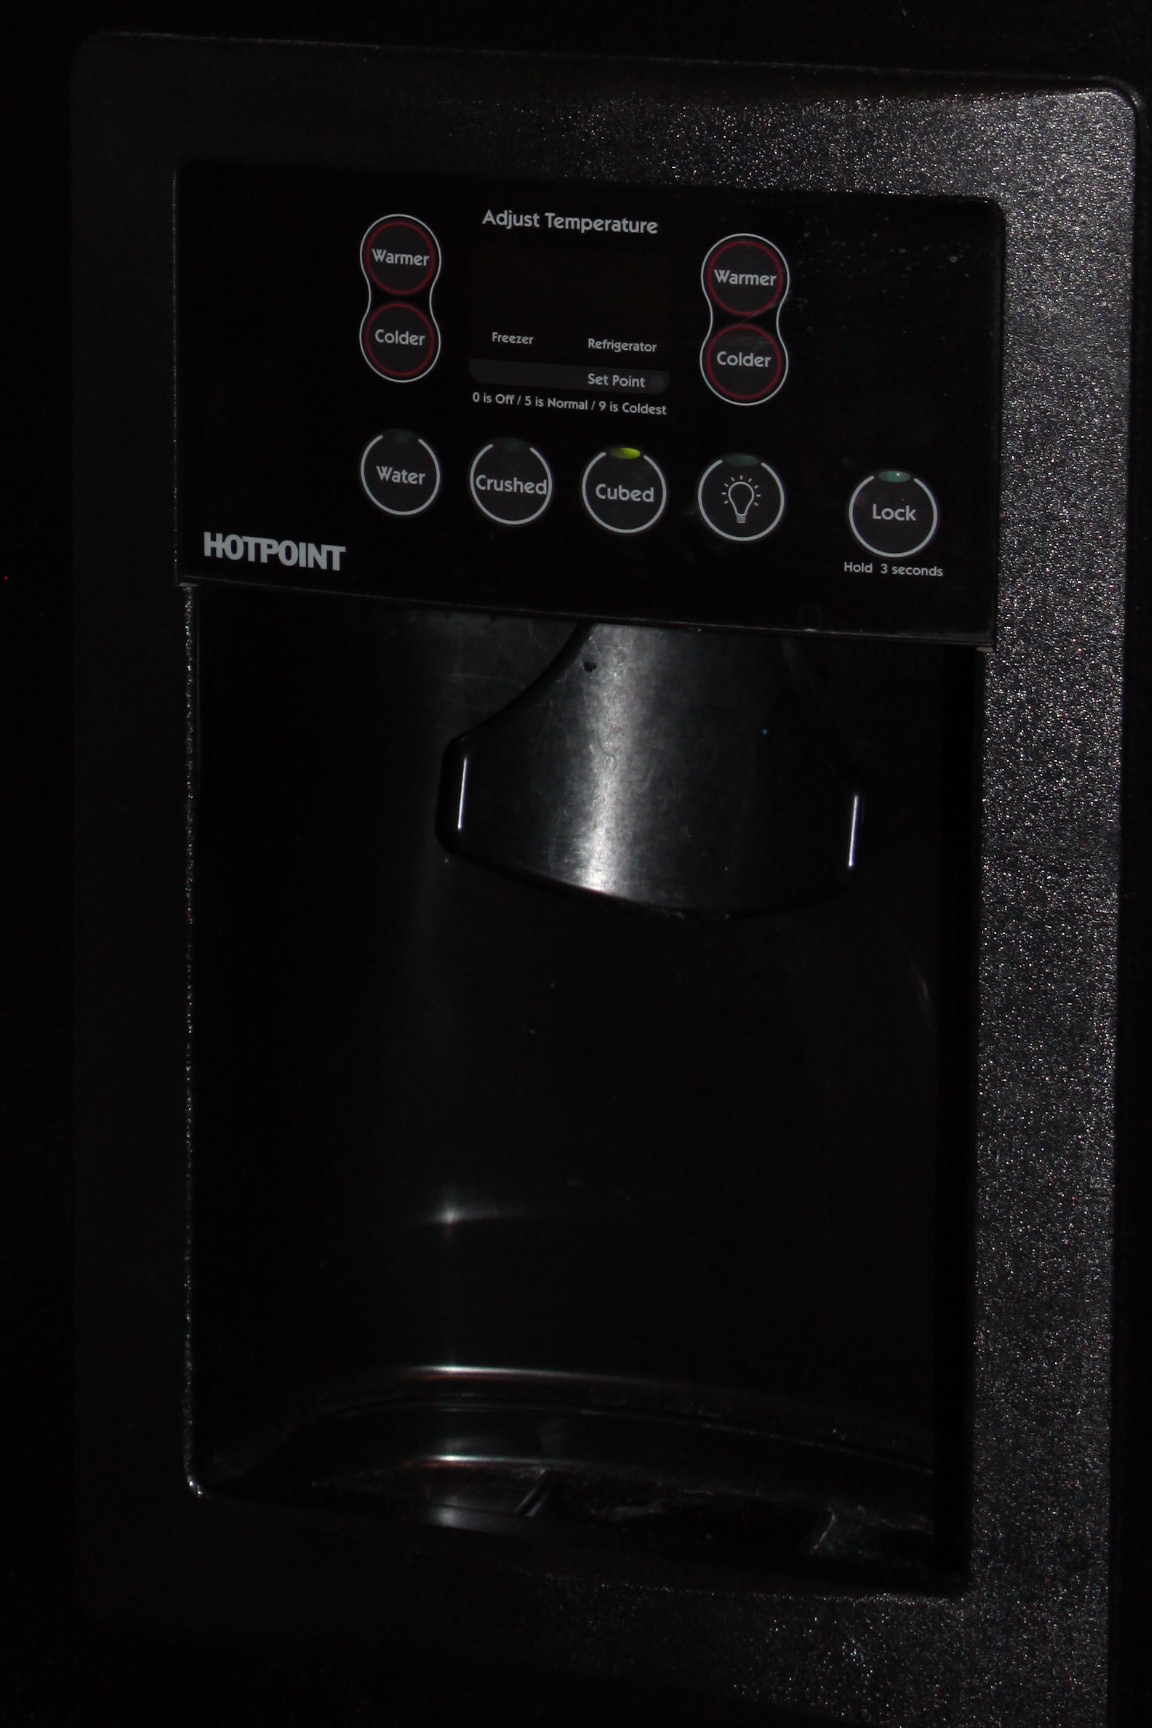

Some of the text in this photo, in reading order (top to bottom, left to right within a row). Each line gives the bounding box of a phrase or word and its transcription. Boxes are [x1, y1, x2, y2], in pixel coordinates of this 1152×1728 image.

[481, 209, 659, 234] Adjust Temperature
[371, 248, 430, 267] Warmer
[714, 269, 777, 287] Warmer
[374, 328, 426, 346] Colder
[492, 331, 534, 345] Freezer
[588, 337, 657, 353] Refrigerator
[716, 350, 772, 368] Colder
[587, 372, 646, 388] Set Point
[472, 391, 480, 403] 0
[483, 392, 492, 404] is
[495, 393, 515, 405] Off
[524, 395, 532, 407] 5
[535, 396, 544, 407] is
[547, 397, 588, 410] Normal
[598, 400, 607, 411] 9
[609, 401, 619, 413] is
[621, 402, 667, 416] Coldest
[375, 465, 426, 485] Water
[475, 474, 547, 495] Crushed
[595, 483, 655, 503] Cubed
[872, 503, 917, 522] Lock
[203, 531, 346, 571] HOTPOINT
[844, 561, 944, 577] Hold 3 seconds
